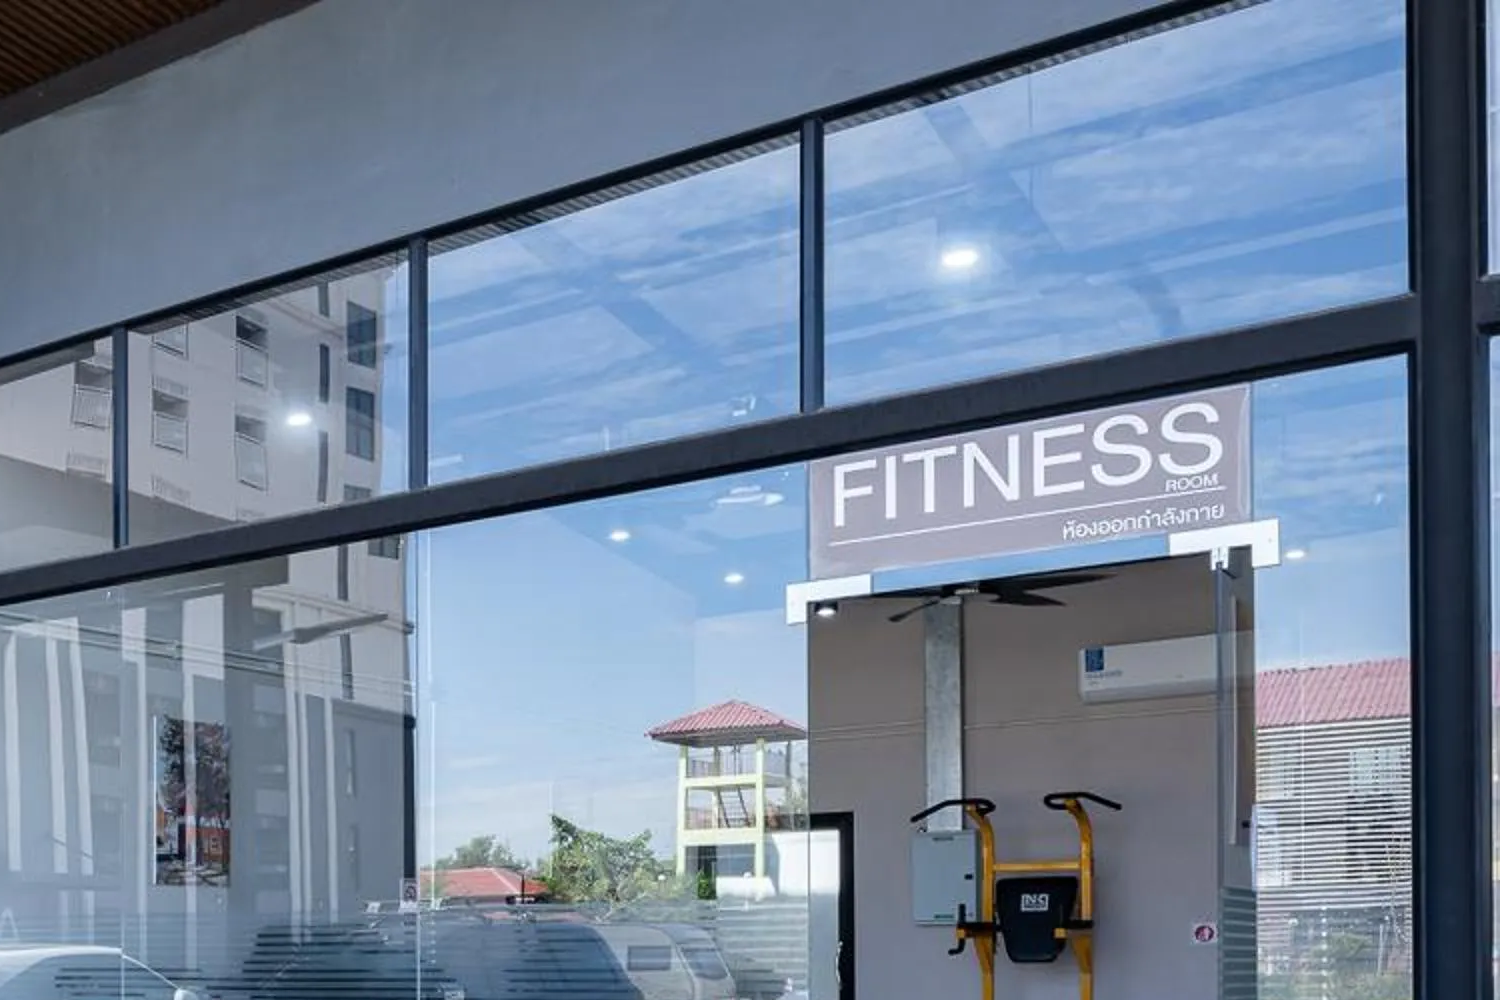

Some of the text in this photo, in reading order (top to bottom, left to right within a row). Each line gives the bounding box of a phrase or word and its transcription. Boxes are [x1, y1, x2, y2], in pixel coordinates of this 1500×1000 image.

[833, 402, 1223, 527] FITNESS
[1165, 473, 1219, 492] ROOM
[1062, 503, 1226, 540] ห้องออกกำลังกาย
